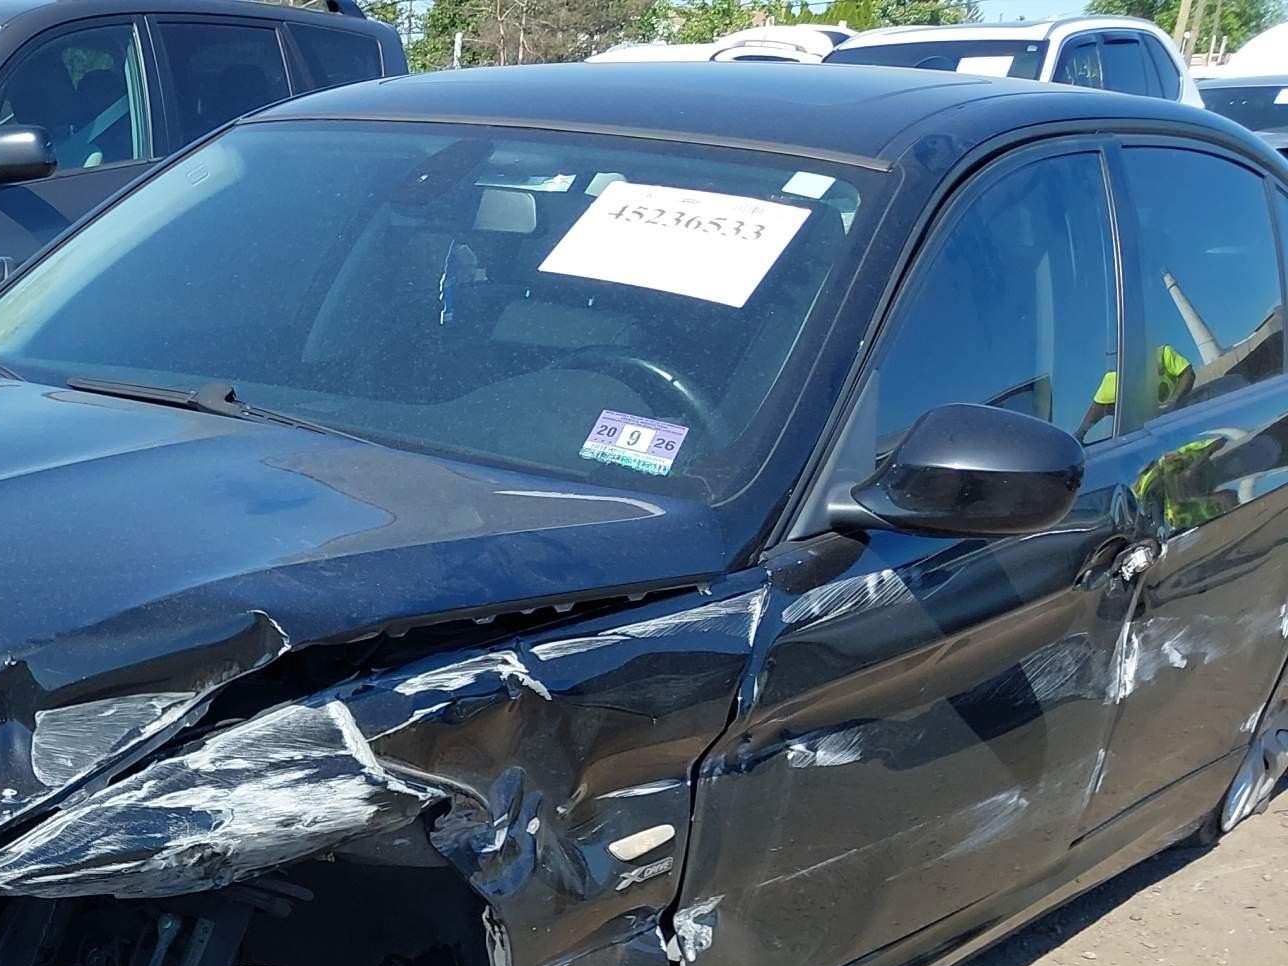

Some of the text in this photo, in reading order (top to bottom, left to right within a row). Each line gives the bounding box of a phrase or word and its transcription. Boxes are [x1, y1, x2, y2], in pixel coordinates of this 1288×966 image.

[608, 204, 766, 240] 45236533
[596, 424, 676, 451] 20 9 26
